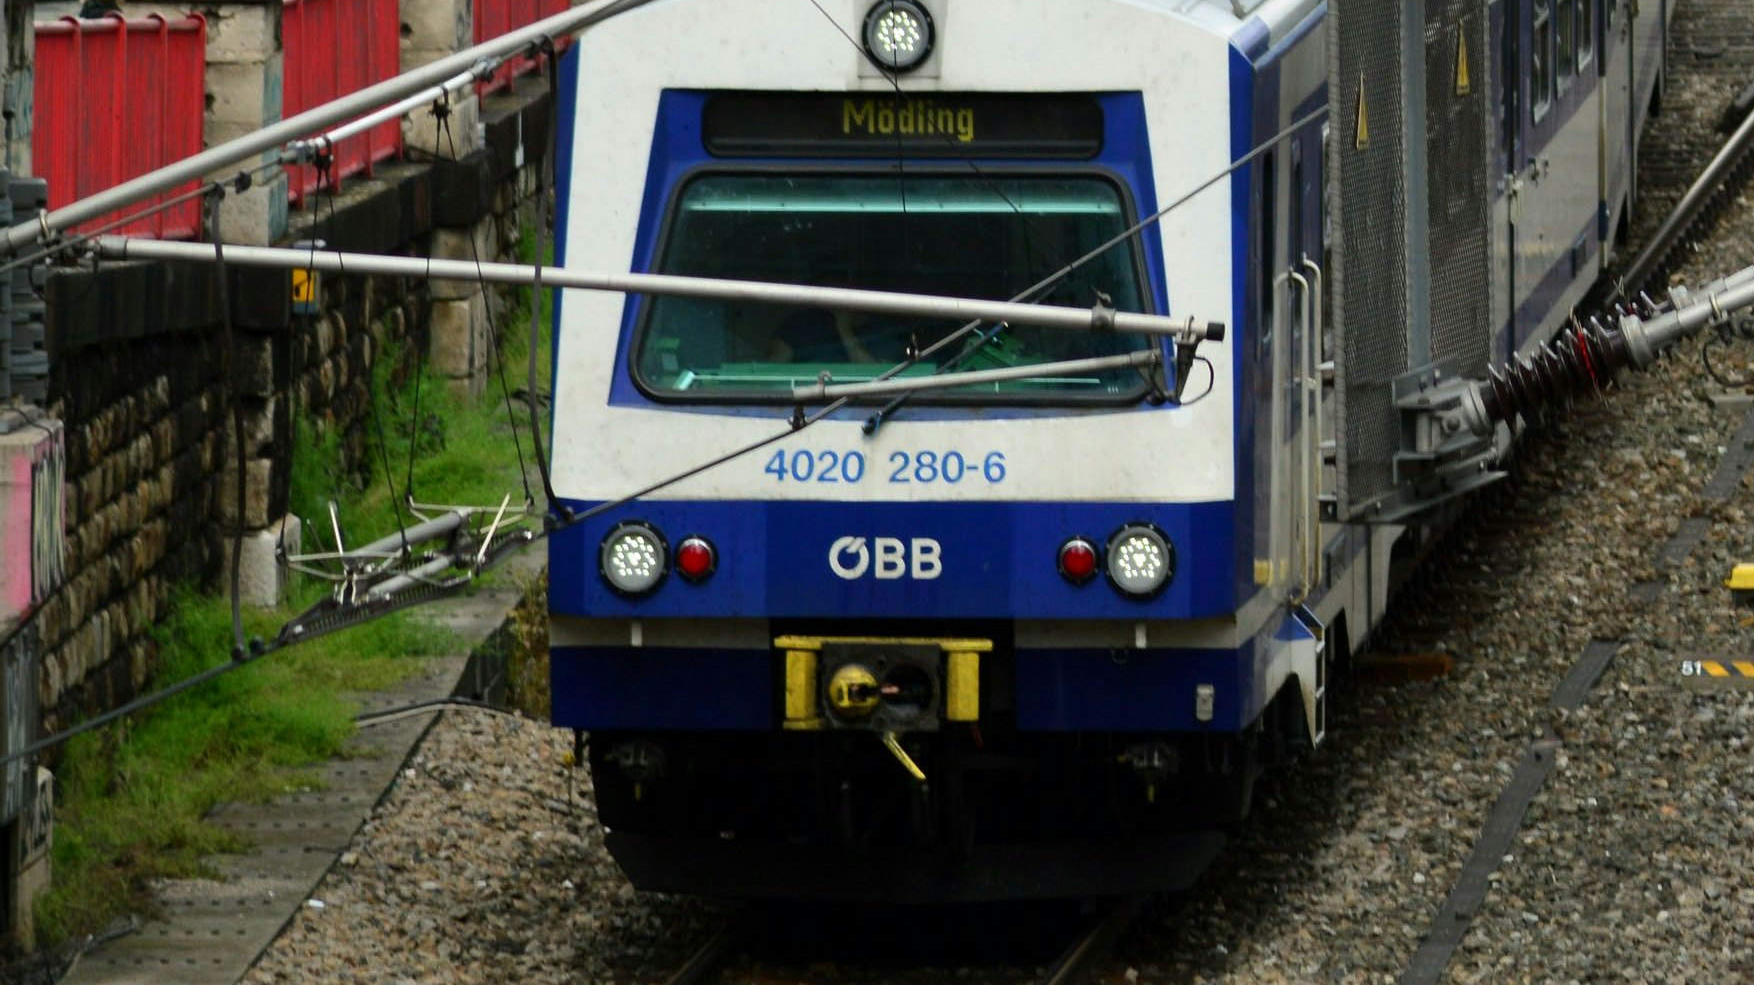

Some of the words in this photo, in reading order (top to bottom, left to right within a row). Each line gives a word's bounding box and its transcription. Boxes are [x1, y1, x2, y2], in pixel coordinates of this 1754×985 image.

[842, 98, 974, 143] Mödling
[764, 448, 866, 482] 4020
[888, 450, 1007, 484] 280-6
[828, 535, 943, 580] ÖBB
[1681, 660, 1702, 676] 51
